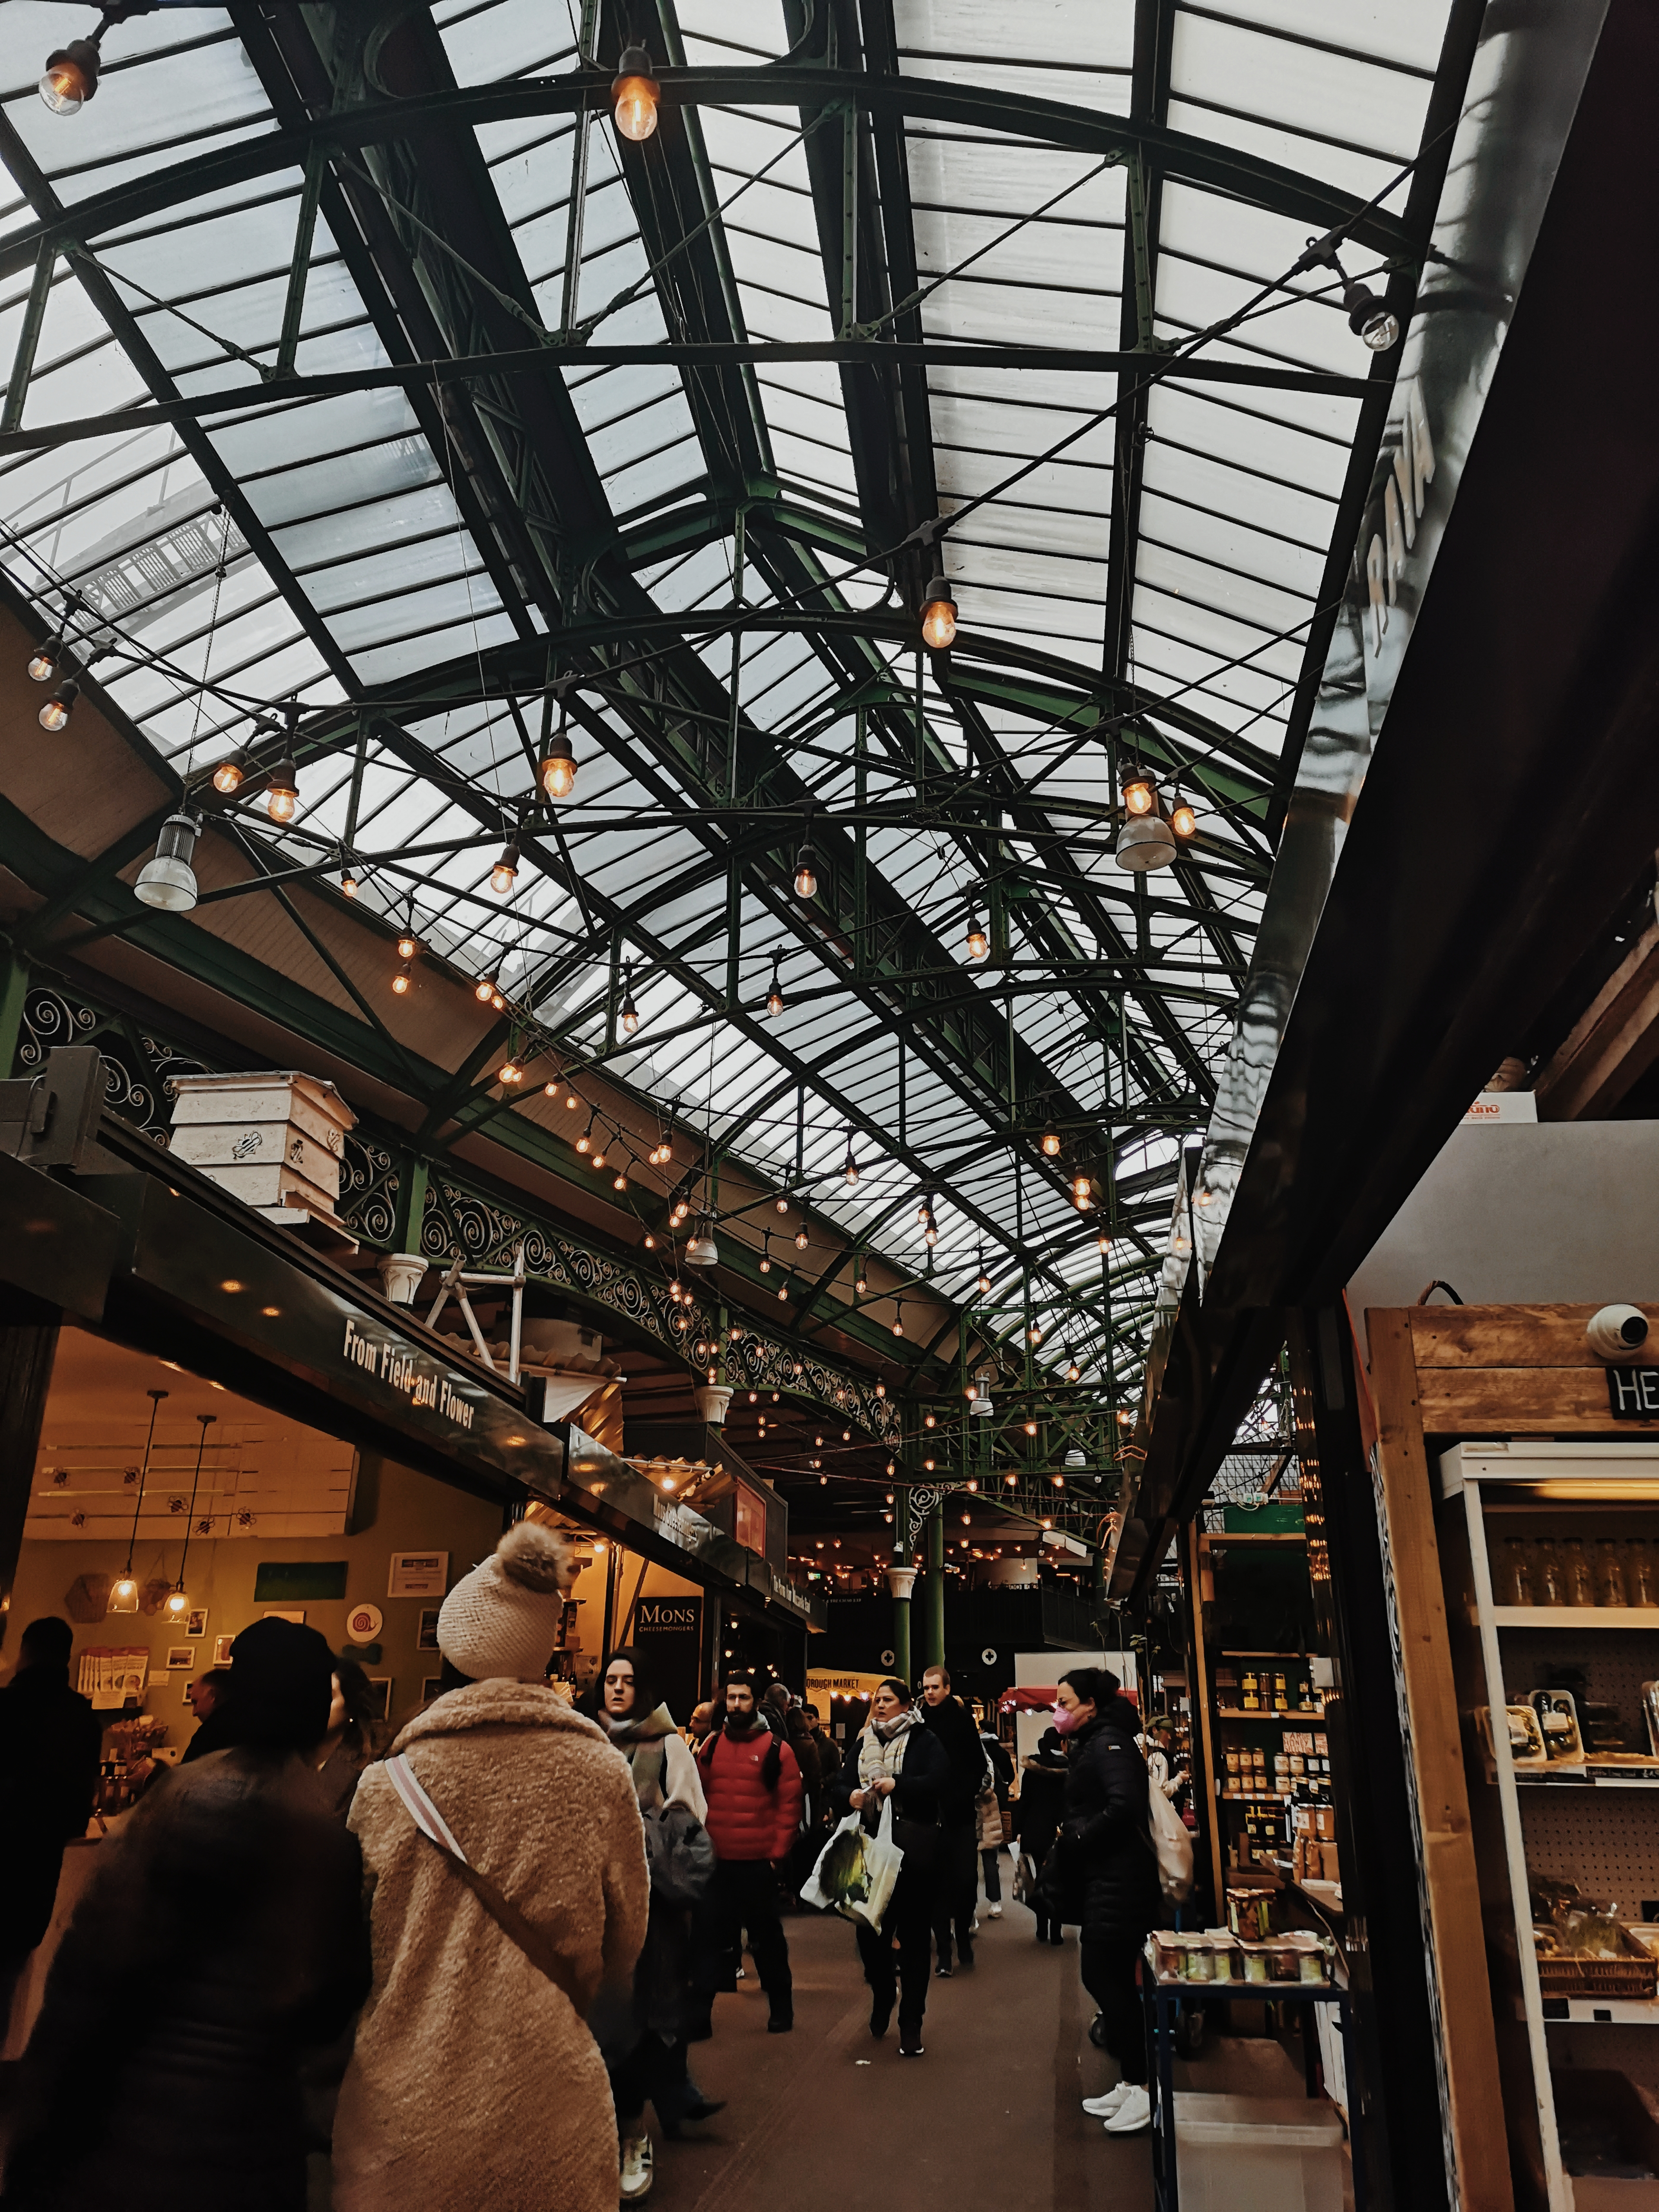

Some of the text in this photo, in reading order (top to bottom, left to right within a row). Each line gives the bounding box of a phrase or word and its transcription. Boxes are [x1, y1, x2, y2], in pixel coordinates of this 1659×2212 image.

[343, 1319, 474, 1429] From Field and Flower
[1613, 1368, 1659, 1411] HE
[806, 1678, 859, 1688] OROUGH MARKET
